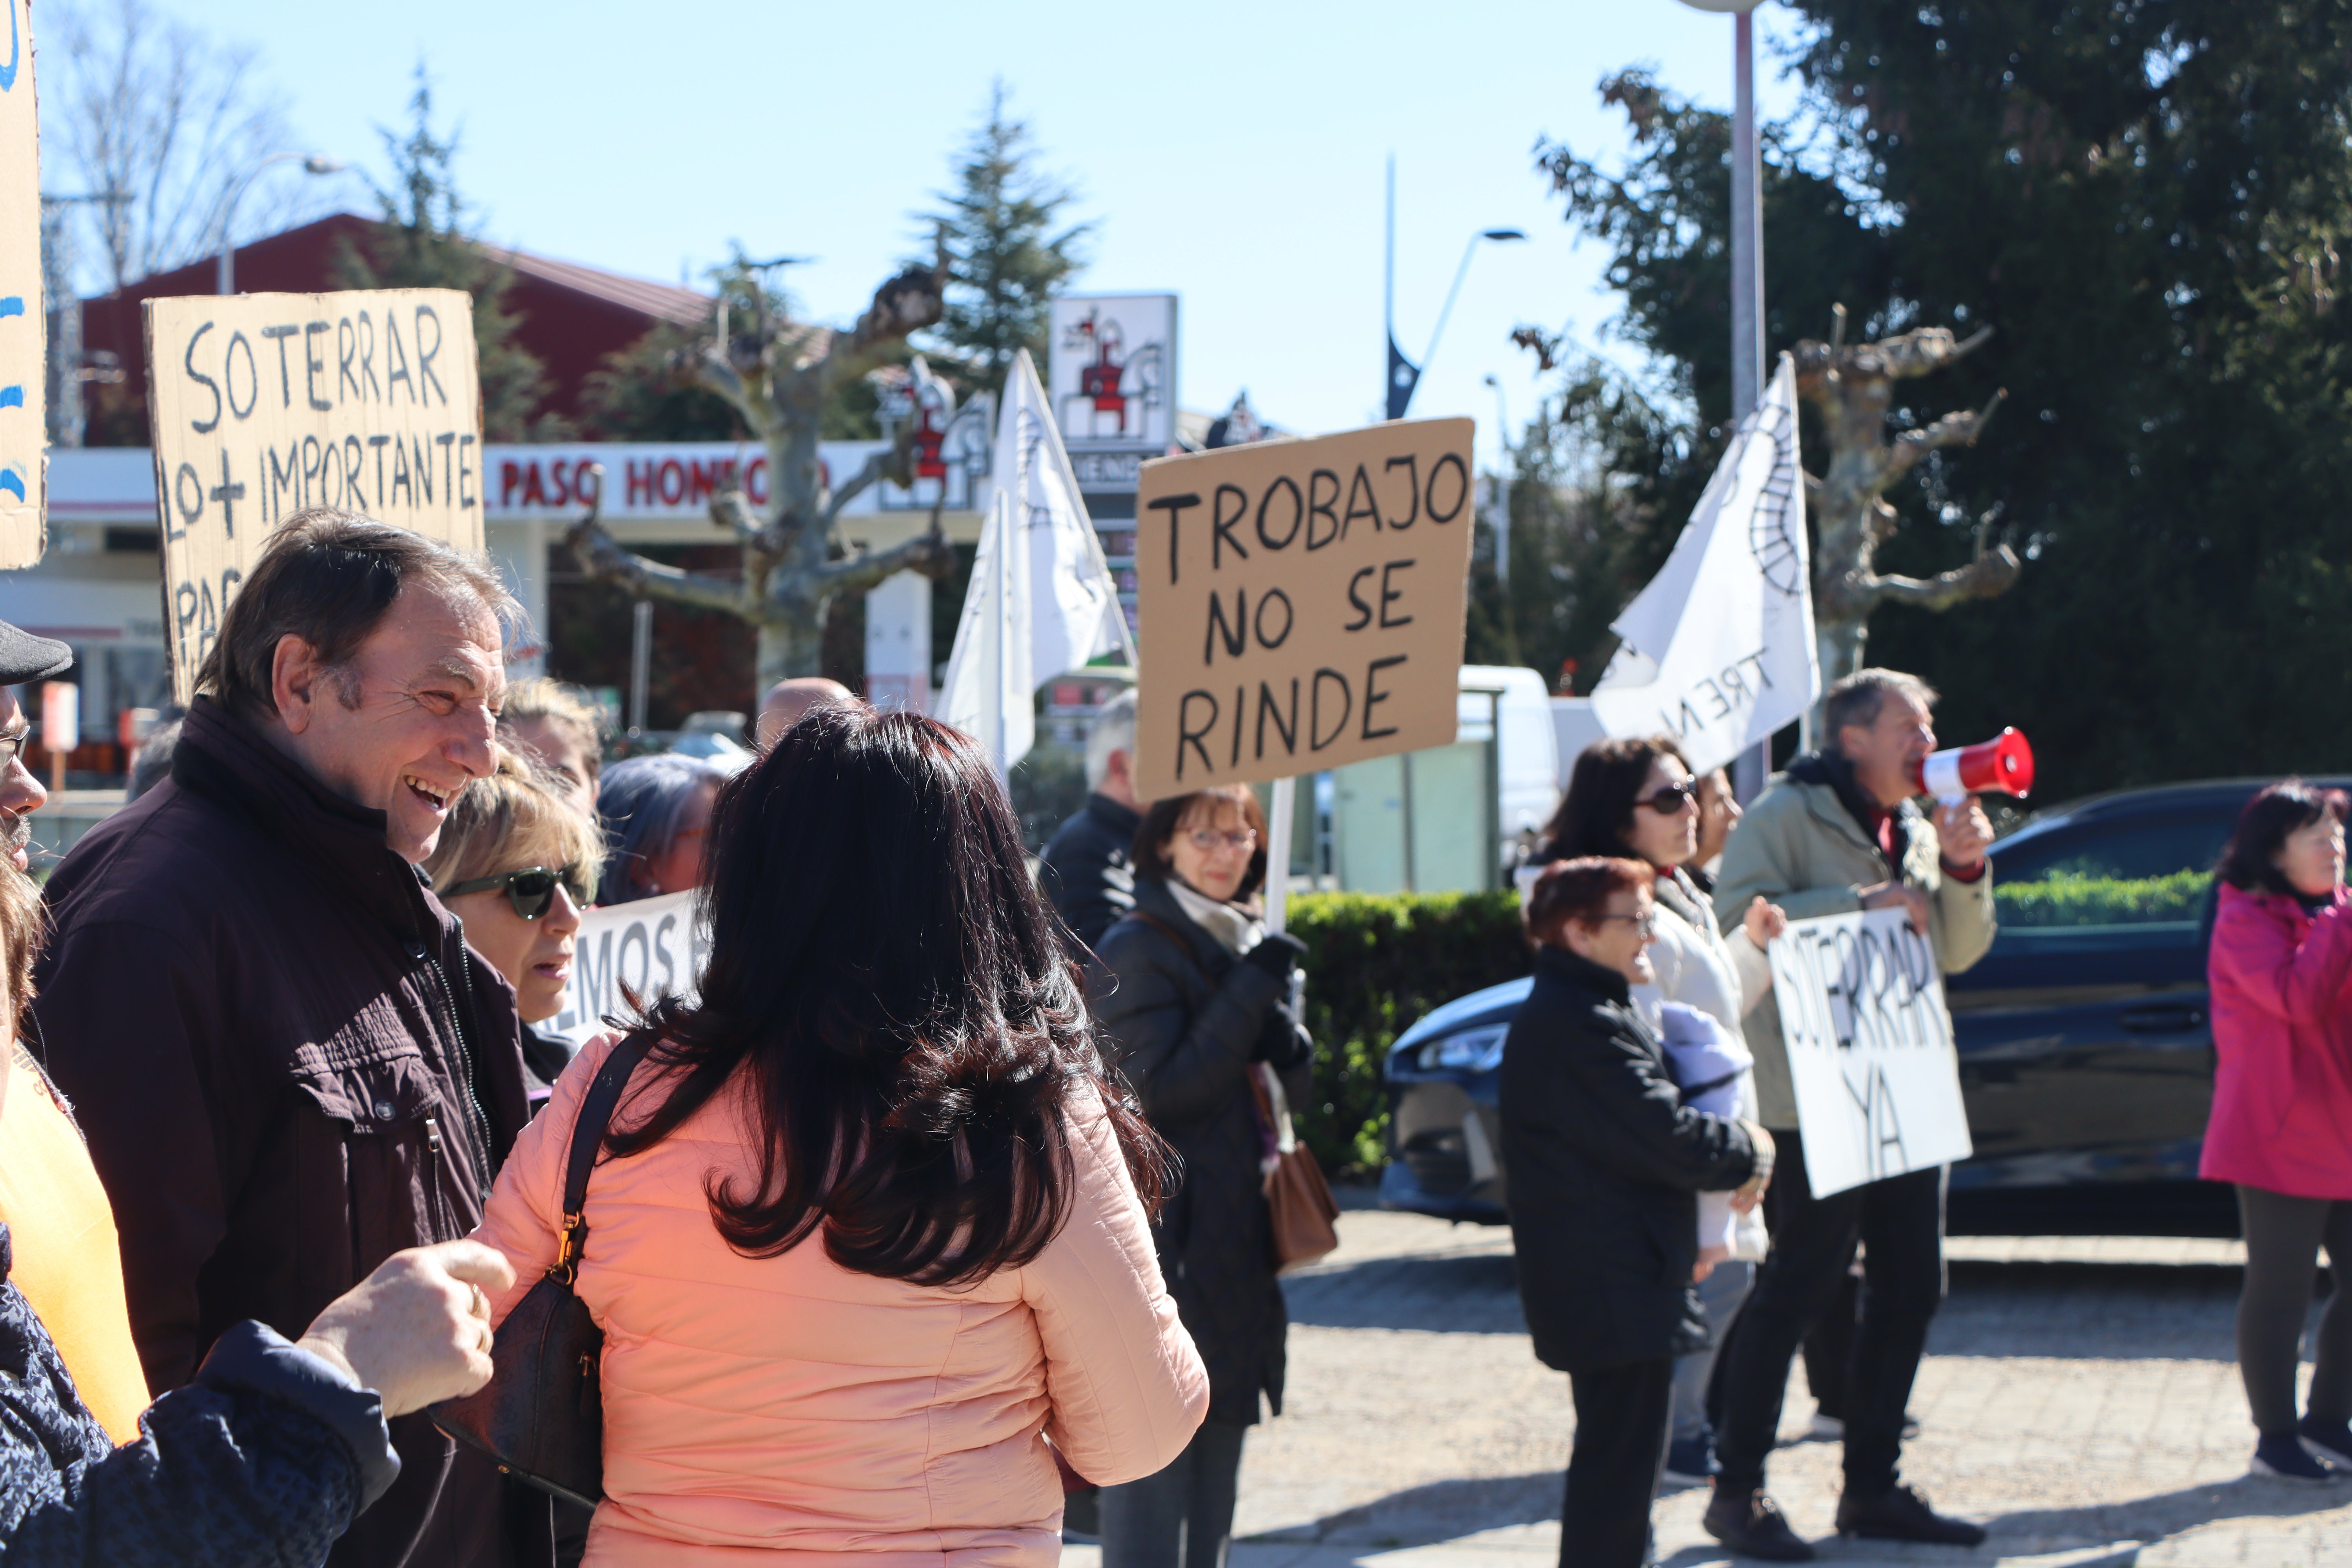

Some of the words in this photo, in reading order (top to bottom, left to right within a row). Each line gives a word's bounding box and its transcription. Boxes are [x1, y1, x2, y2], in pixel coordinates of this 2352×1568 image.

[186, 305, 447, 434] SOTERRAR
[260, 430, 475, 525] IMPORTANTE
[501, 457, 599, 506] PASO
[1147, 453, 1468, 585] TROBAJO
[1205, 587, 1293, 665] NO
[1345, 559, 1416, 631] SE
[1176, 654, 1408, 781] RINDE
[1841, 1059, 1909, 1179] YA
